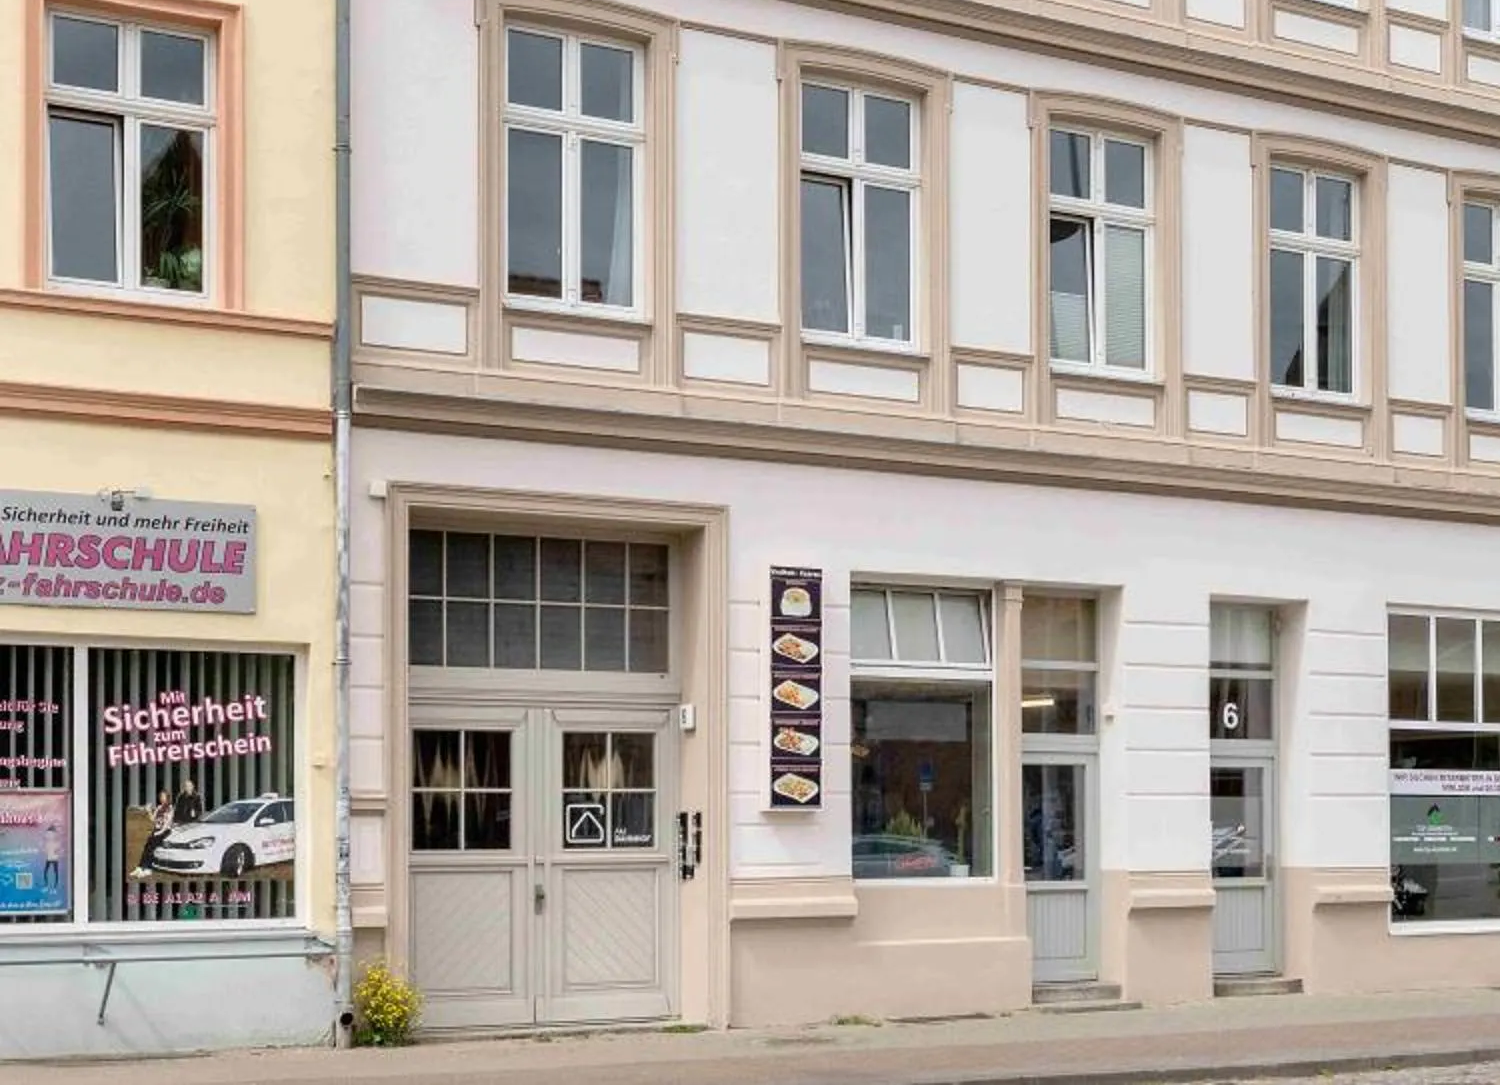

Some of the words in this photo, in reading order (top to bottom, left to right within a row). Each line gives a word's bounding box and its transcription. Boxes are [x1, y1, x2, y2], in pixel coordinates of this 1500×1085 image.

[2, 506, 91, 526] Sicherheit
[96, 511, 129, 528] und
[134, 516, 179, 530] mehr
[184, 517, 249, 534] Freiheit
[0, 529, 247, 575] HRSCHULE
[159, 690, 185, 705] Mit
[104, 695, 267, 733] Sicherheit
[1222, 702, 1239, 729] 6
[108, 733, 272, 767] Führerschein
[154, 730, 186, 743] zum
